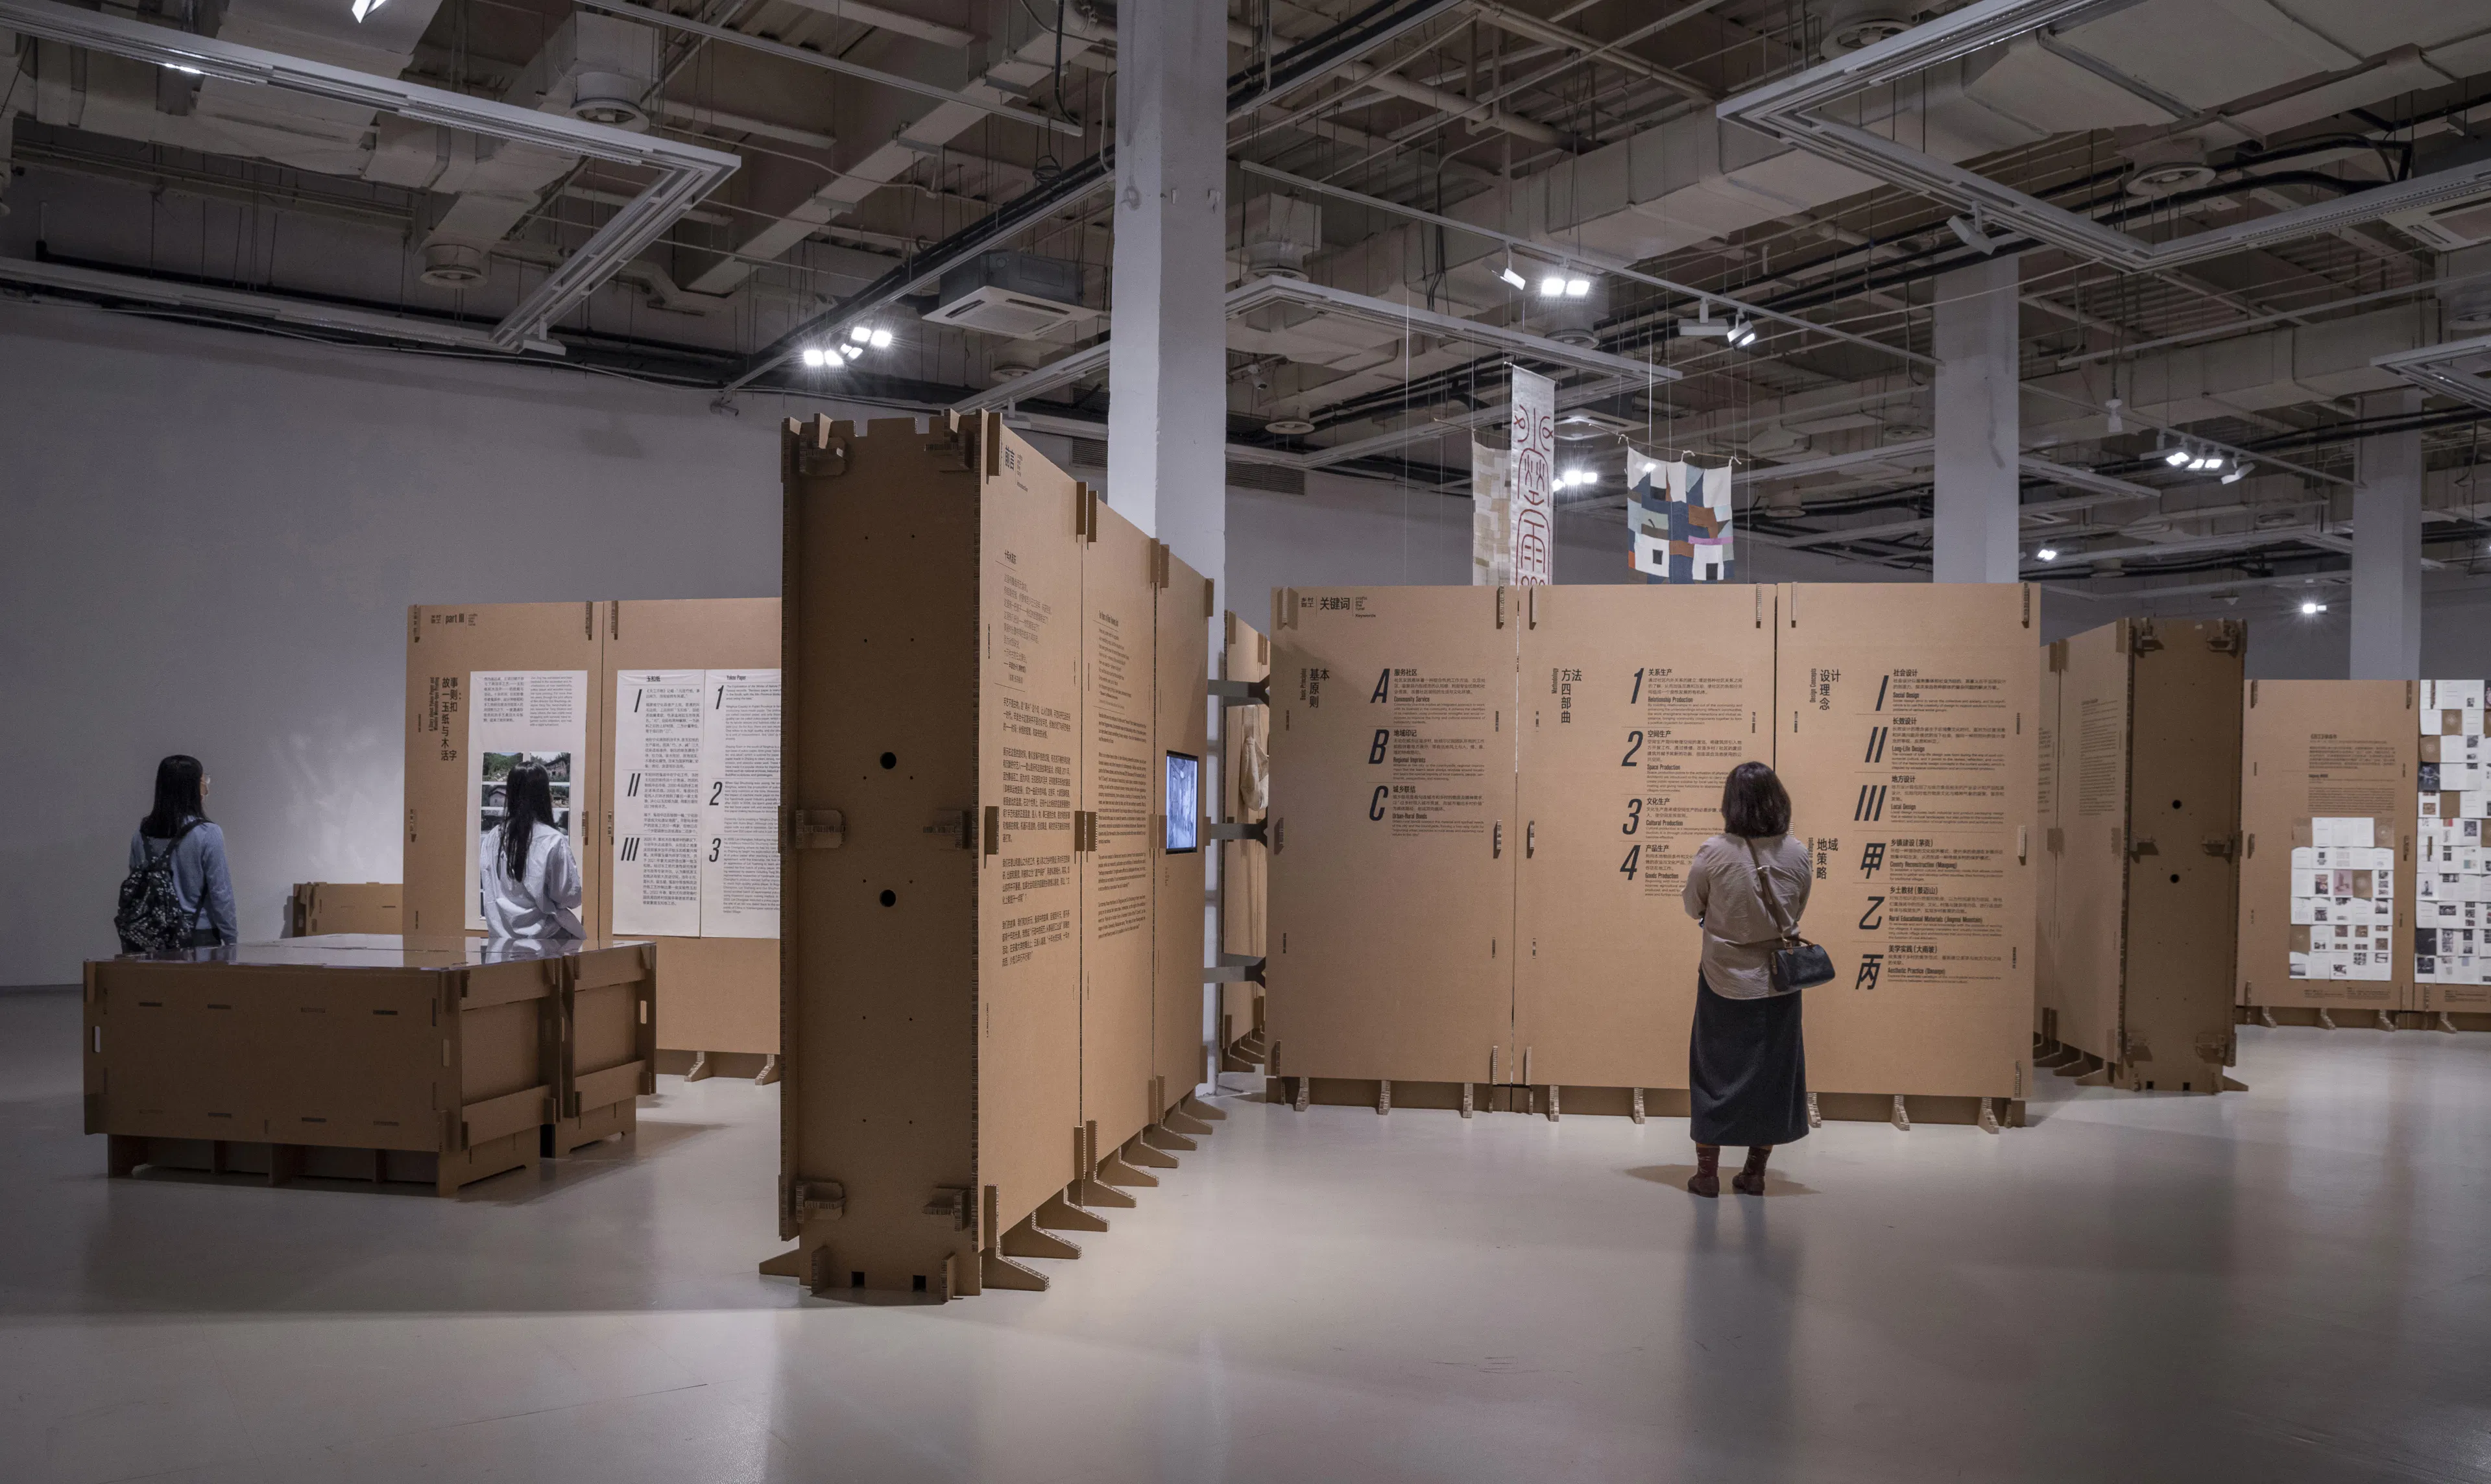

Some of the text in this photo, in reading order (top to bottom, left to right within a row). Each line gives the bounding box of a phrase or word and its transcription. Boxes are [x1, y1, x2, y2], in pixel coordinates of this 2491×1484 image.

[445, 614, 457, 624] part
[1320, 597, 1350, 610] 关键词
[716, 686, 724, 710] 1
[1370, 669, 1390, 703] A
[1631, 668, 1644, 704] 1
[1368, 729, 1390, 764] B
[1622, 731, 1643, 767] 2
[709, 782, 722, 806] 2
[1369, 785, 1388, 821] C
[1622, 798, 1642, 835] 3
[709, 838, 721, 862] 3
[1620, 845, 1641, 880] 4
[1860, 843, 1886, 879] 甲
[1859, 896, 1885, 929] 乙
[1855, 954, 1884, 990] 丙
